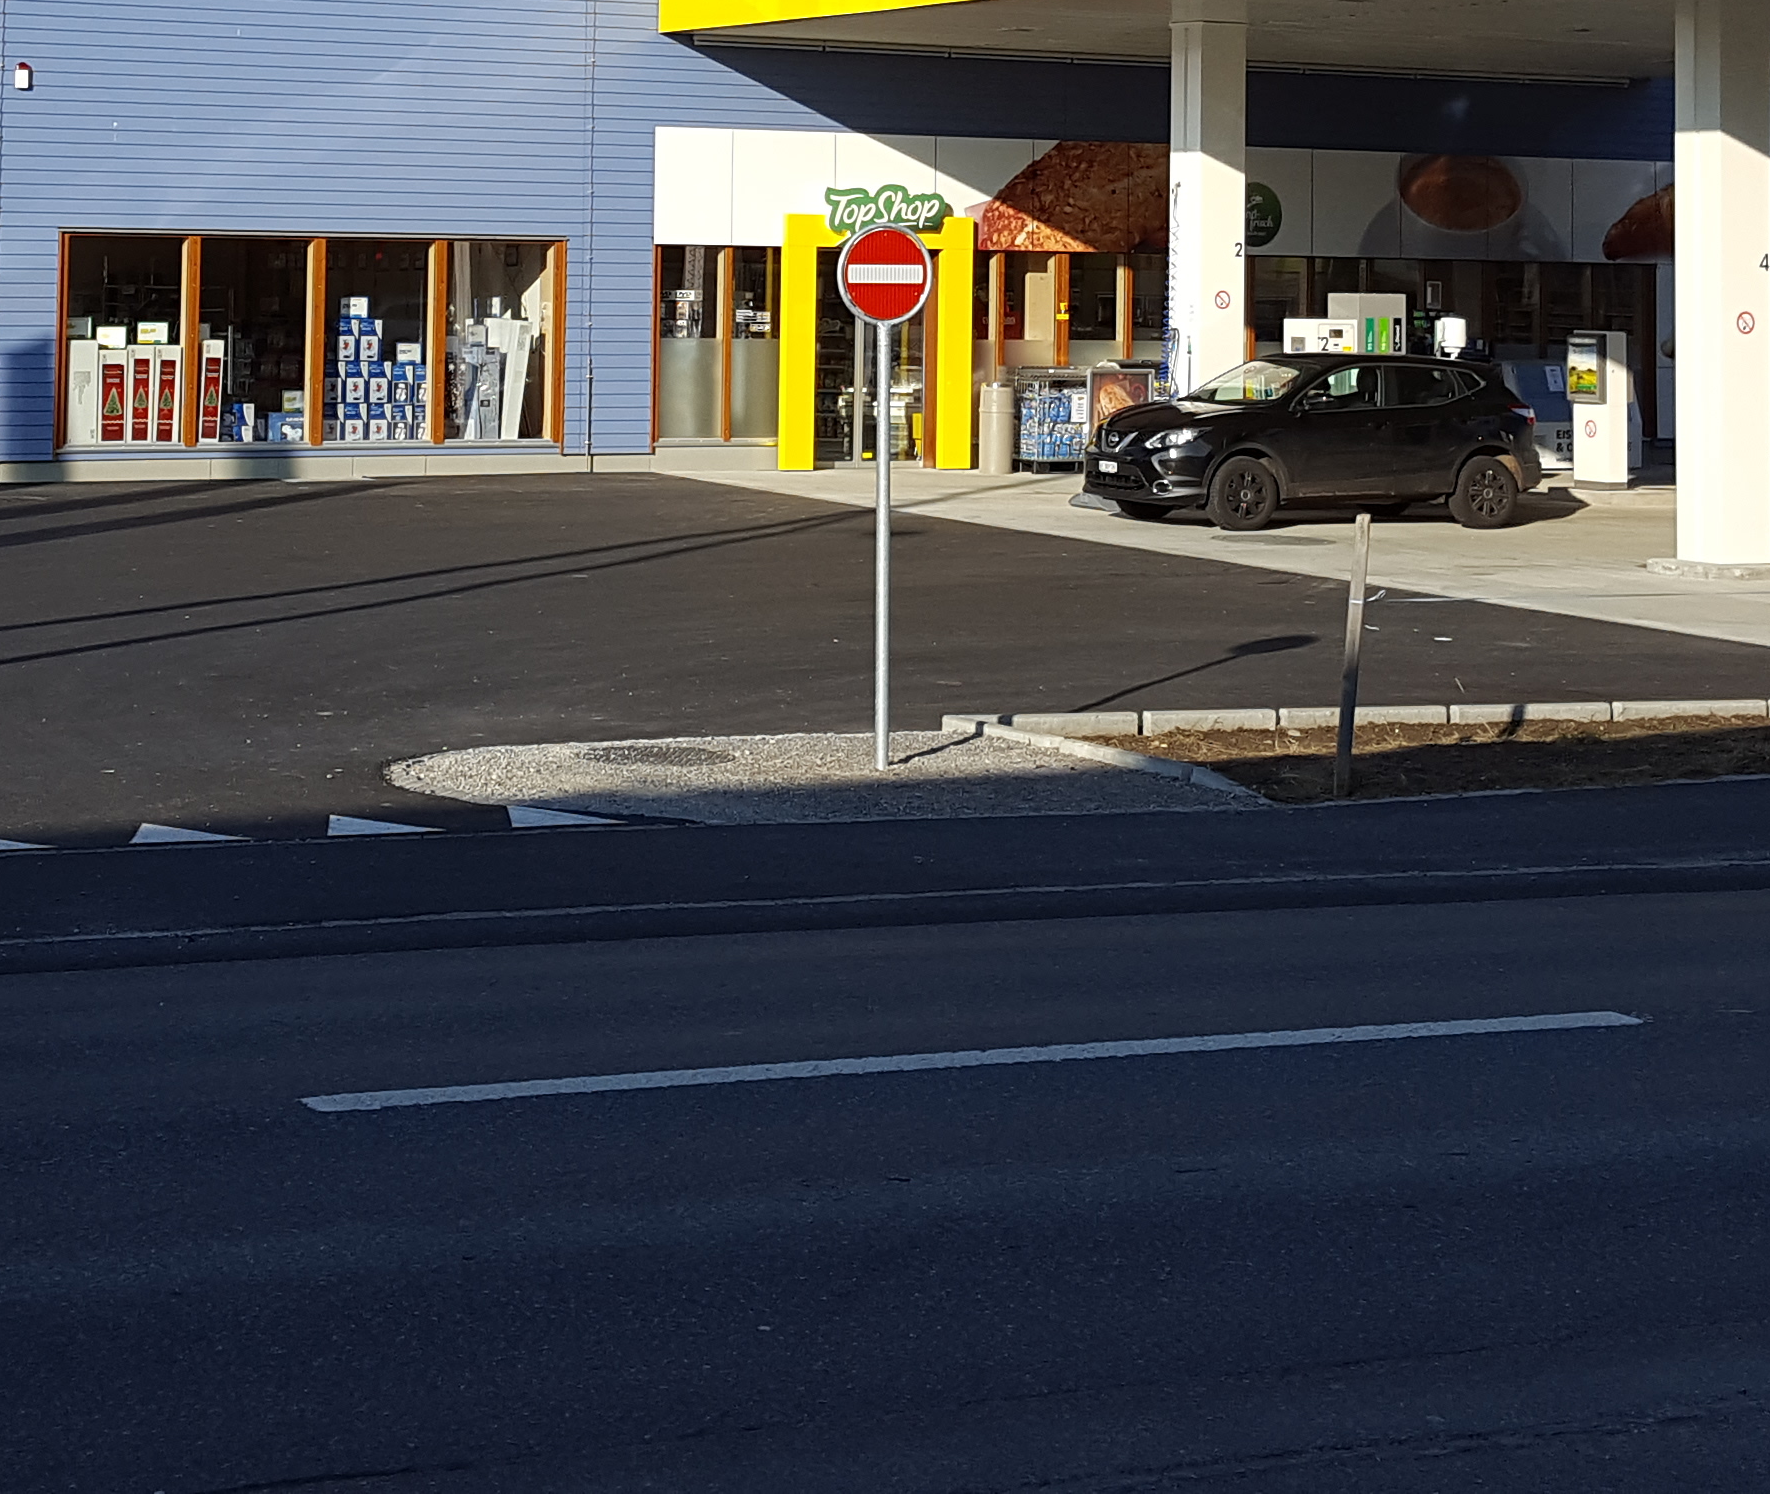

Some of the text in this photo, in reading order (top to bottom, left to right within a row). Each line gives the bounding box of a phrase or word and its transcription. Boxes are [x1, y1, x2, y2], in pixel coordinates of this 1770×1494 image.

[1234, 242, 1243, 257] 2
[1759, 253, 1770, 272] 4
[1320, 337, 1329, 352] 2
